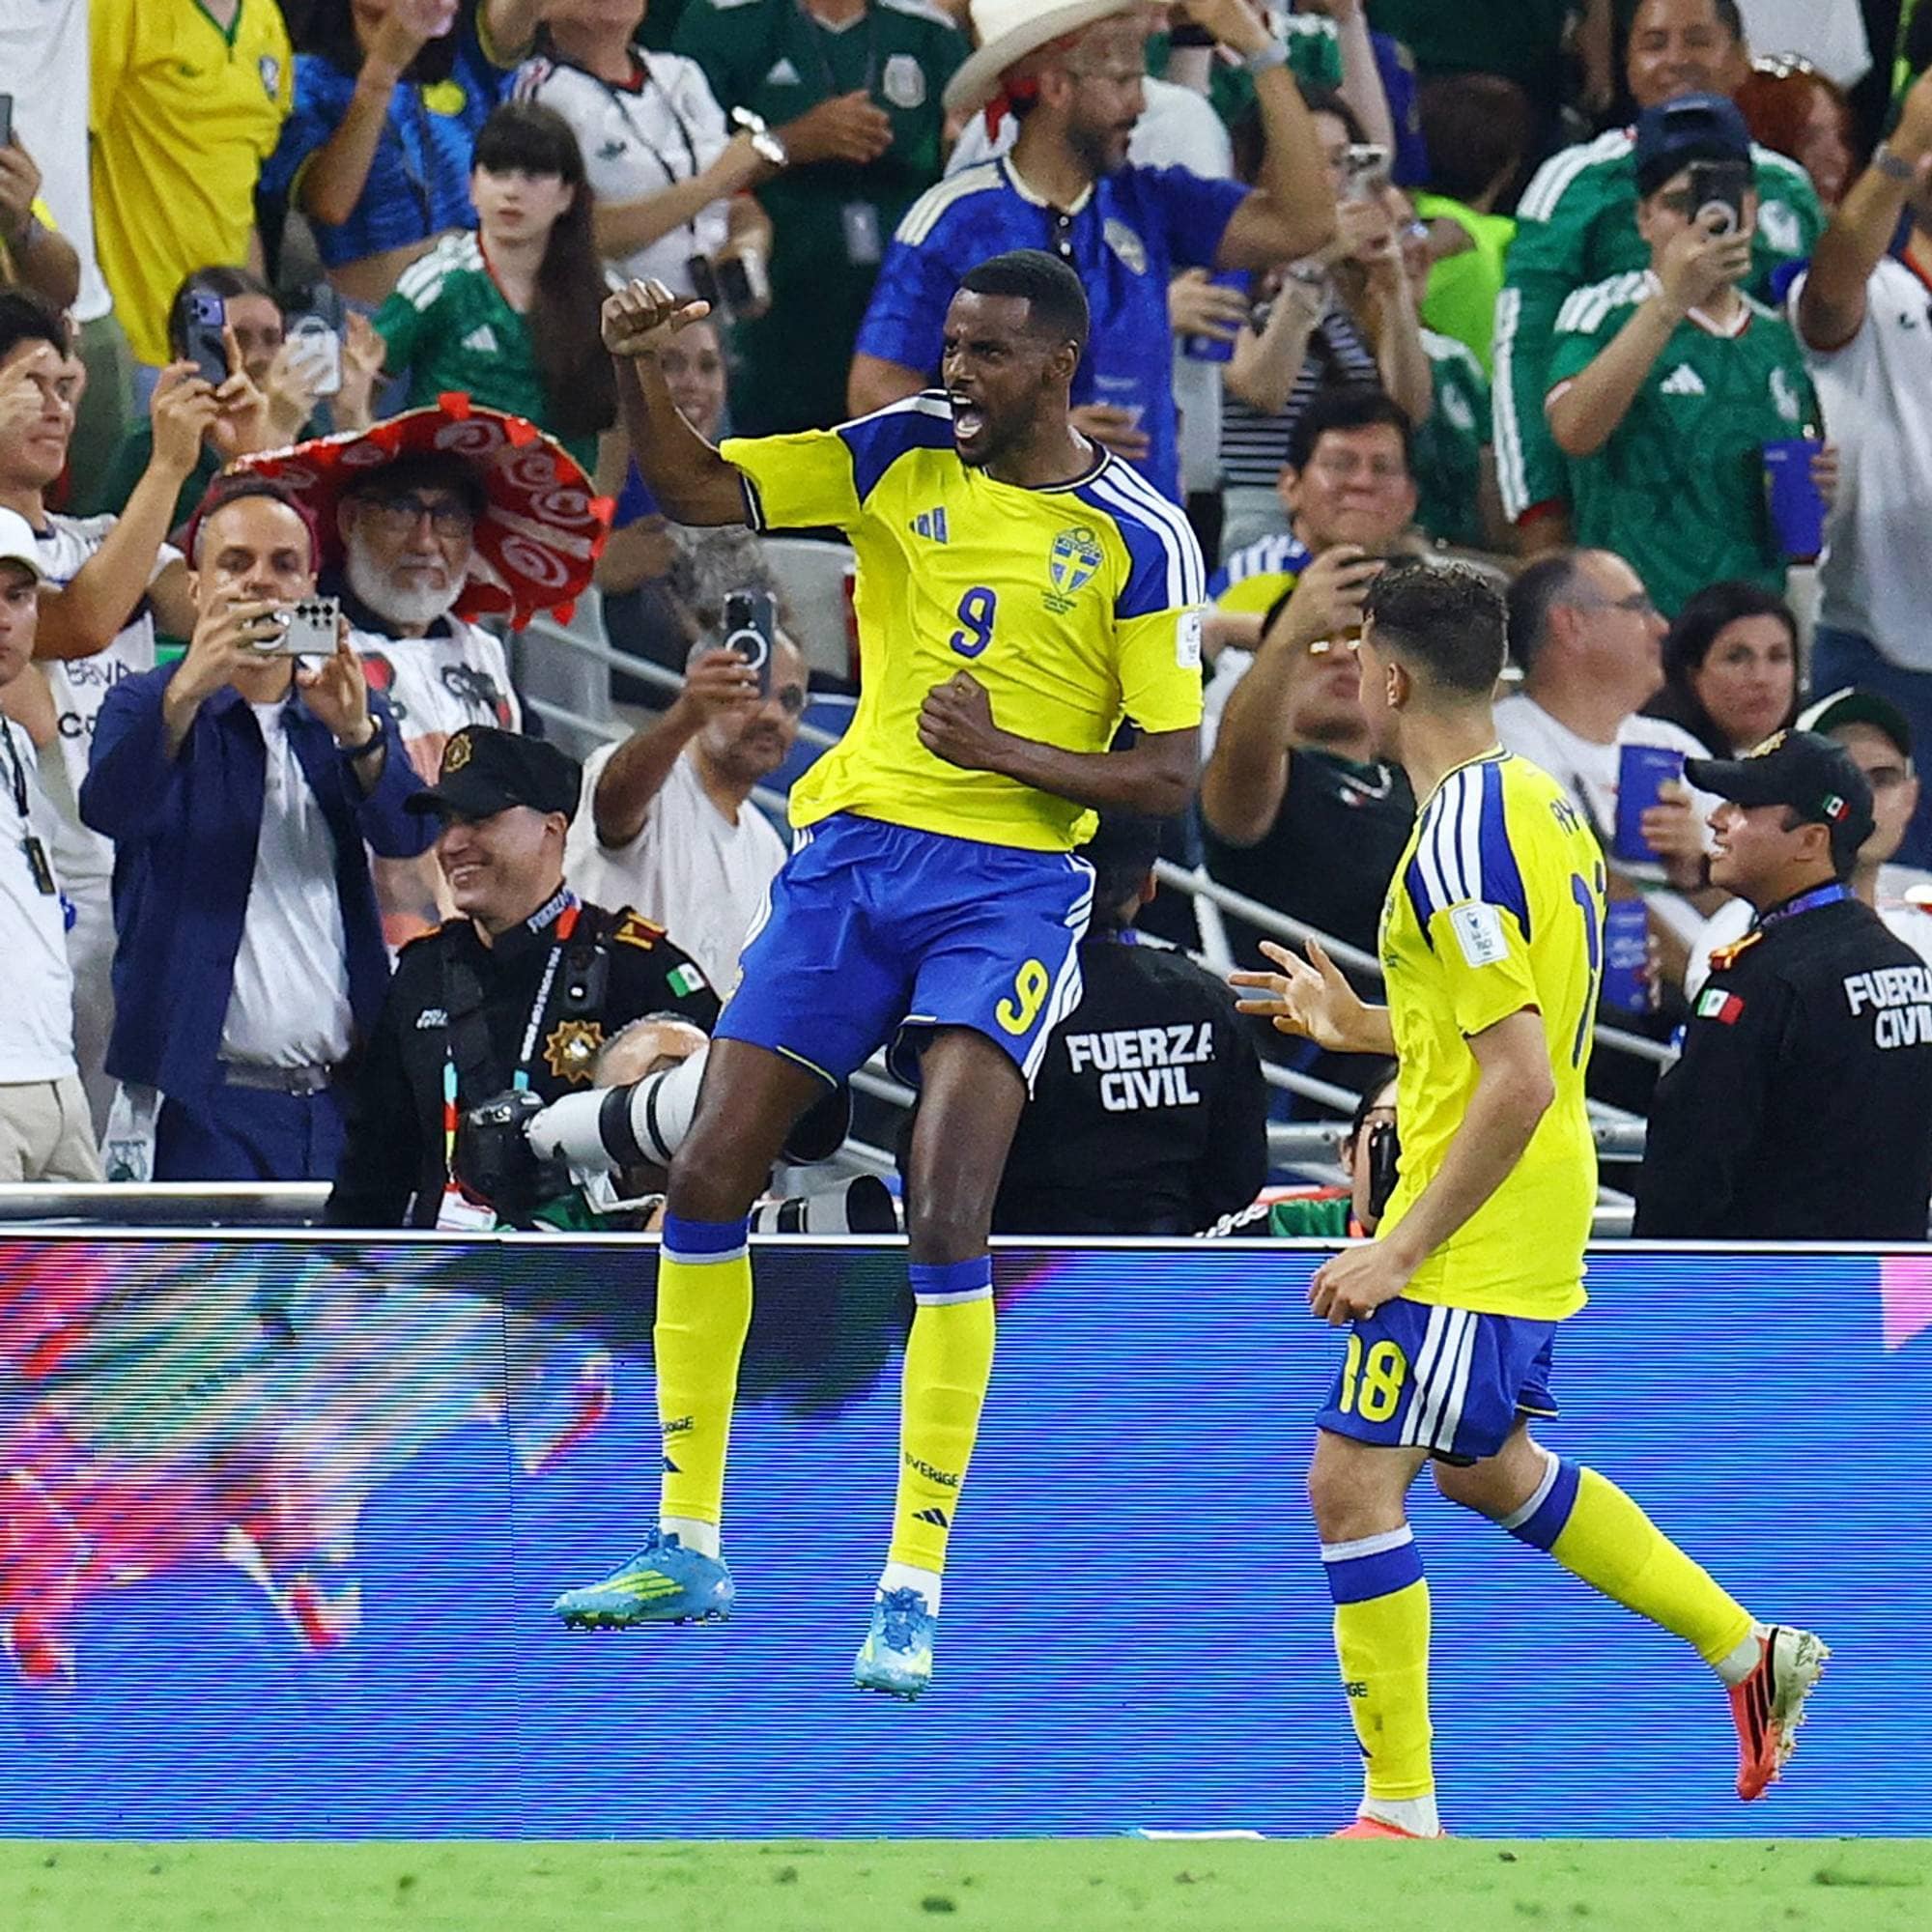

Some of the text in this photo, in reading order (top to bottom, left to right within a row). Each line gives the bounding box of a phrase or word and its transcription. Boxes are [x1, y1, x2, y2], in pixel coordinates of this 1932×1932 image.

[950, 585, 995, 659] 9
[996, 959, 1049, 1036] 9
[1065, 1022, 1216, 1073] FUERZA
[1100, 1066, 1201, 1111] CIVIL
[1339, 1334, 1406, 1422] 18
